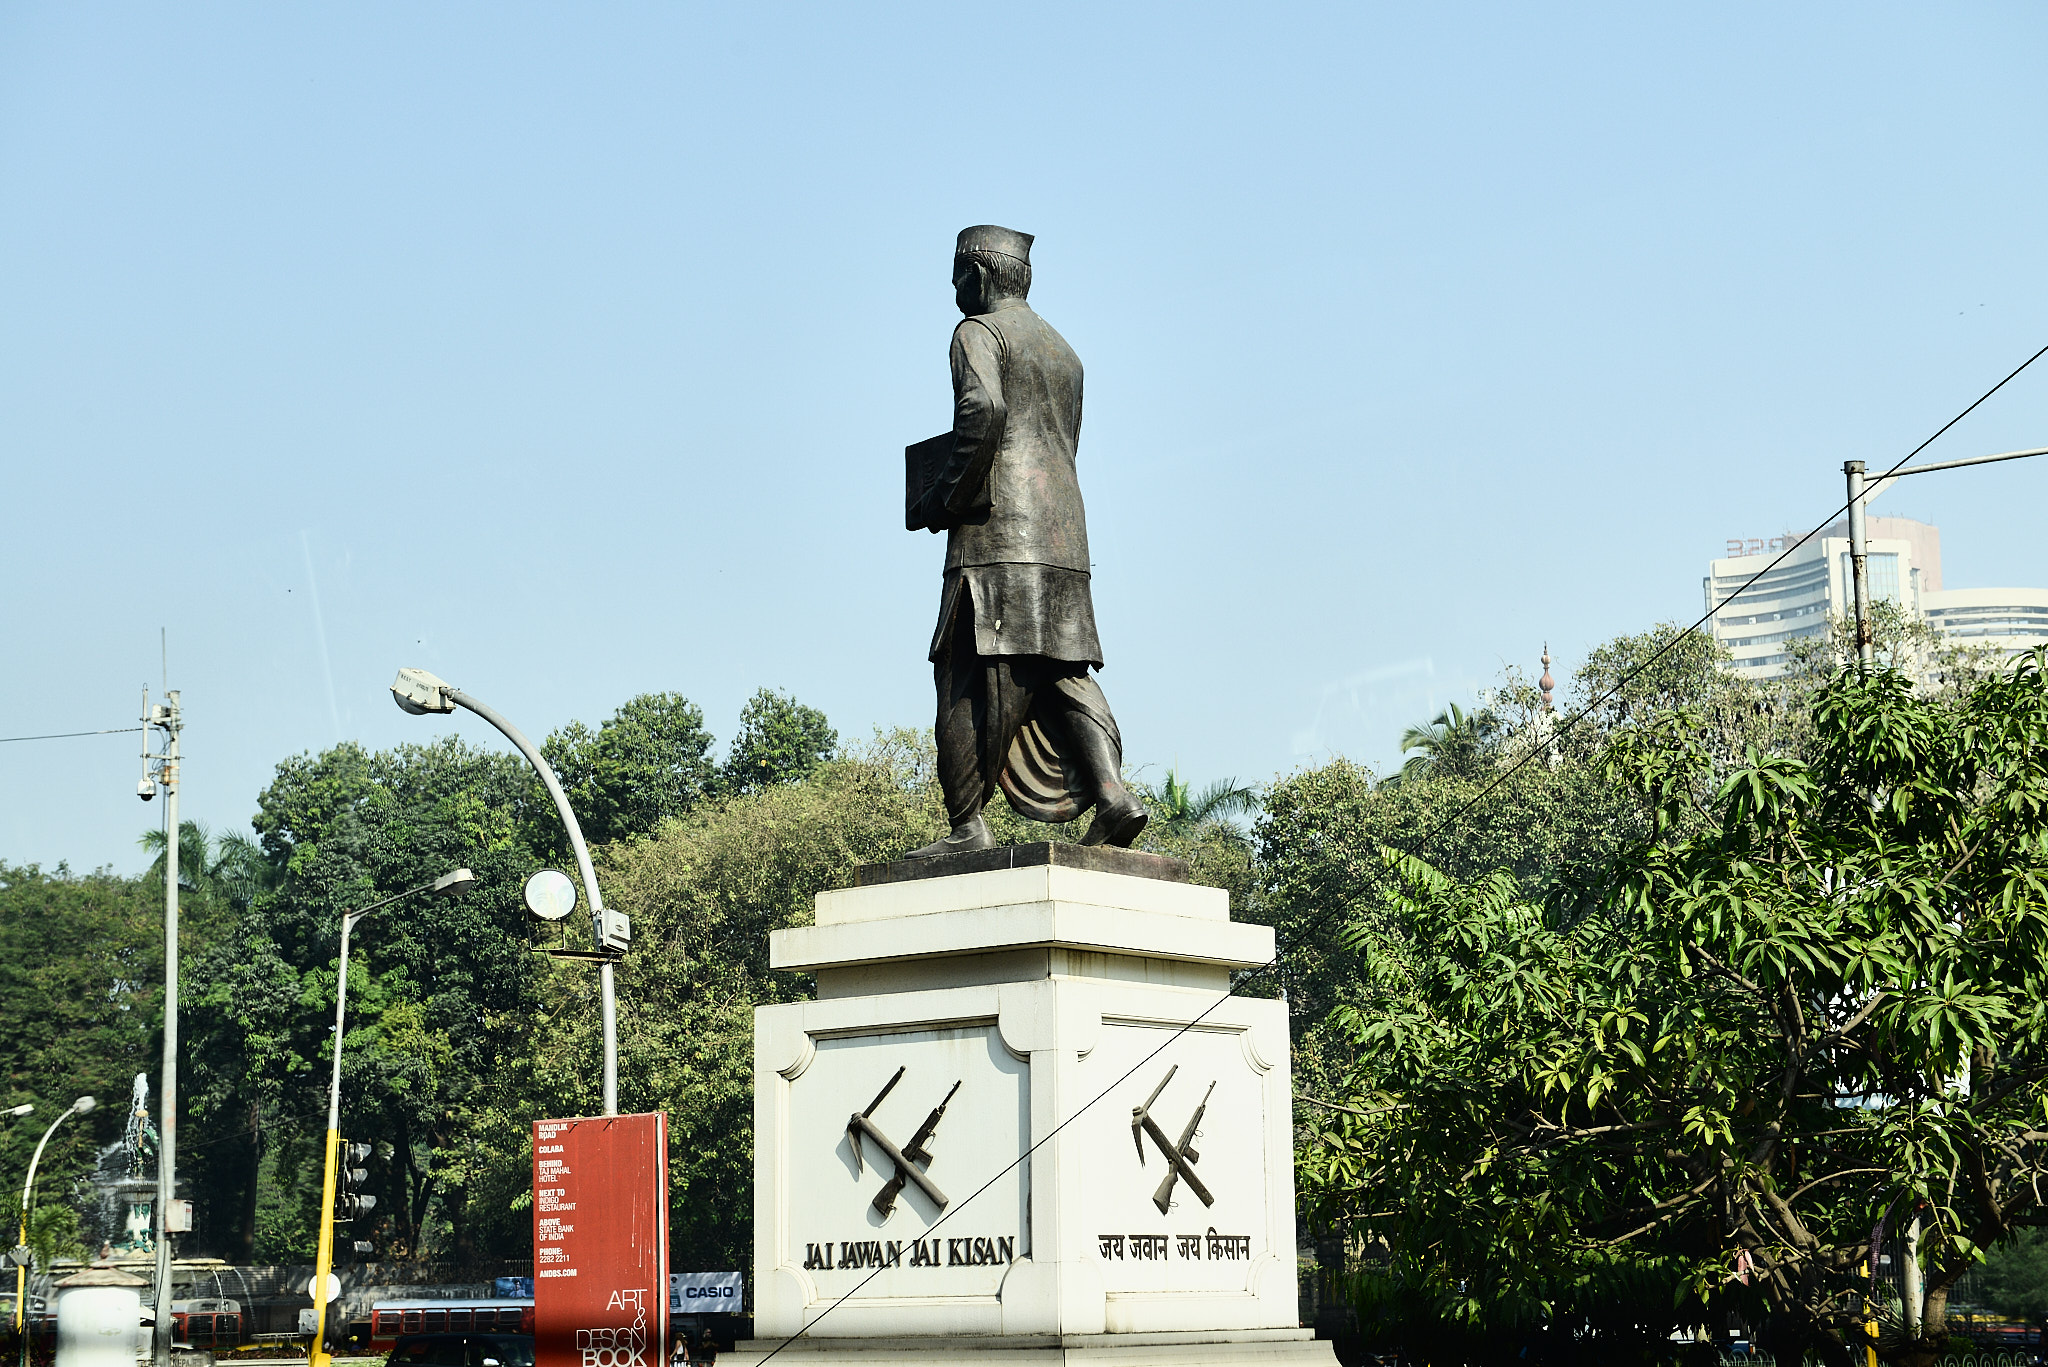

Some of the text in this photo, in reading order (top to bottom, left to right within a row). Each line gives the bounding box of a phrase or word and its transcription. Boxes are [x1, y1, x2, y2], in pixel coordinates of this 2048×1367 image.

[538, 1123, 568, 1132] MANDLIK
[538, 1131, 557, 1140] ROAD
[538, 1145, 564, 1153] COLABA
[538, 1159, 563, 1168] BEHIND
[538, 1166, 571, 1175] TAJ MAHAL
[538, 1174, 558, 1182] HOTEL
[538, 1188, 565, 1197] NEXT TO
[538, 1196, 559, 1204] INDIGO
[538, 1202, 576, 1211] RESTAURANT
[538, 1218, 560, 1226] ABOVE
[538, 1225, 557, 1234] STATE
[539, 1232, 564, 1241] OF INDIA
[1098, 1226, 1251, 1261] जय जवान जय किसान
[539, 1247, 562, 1255] PHONE:
[803, 1236, 1015, 1270] JAI JAWAN JAI KISAN
[555, 1254, 570, 1262] 2211
[686, 1286, 733, 1298] CASIO
[606, 1289, 648, 1311] ART
[633, 1307, 646, 1330] &
[576, 1327, 647, 1350] DESIGN
[582, 1346, 648, 1367] BOOK
